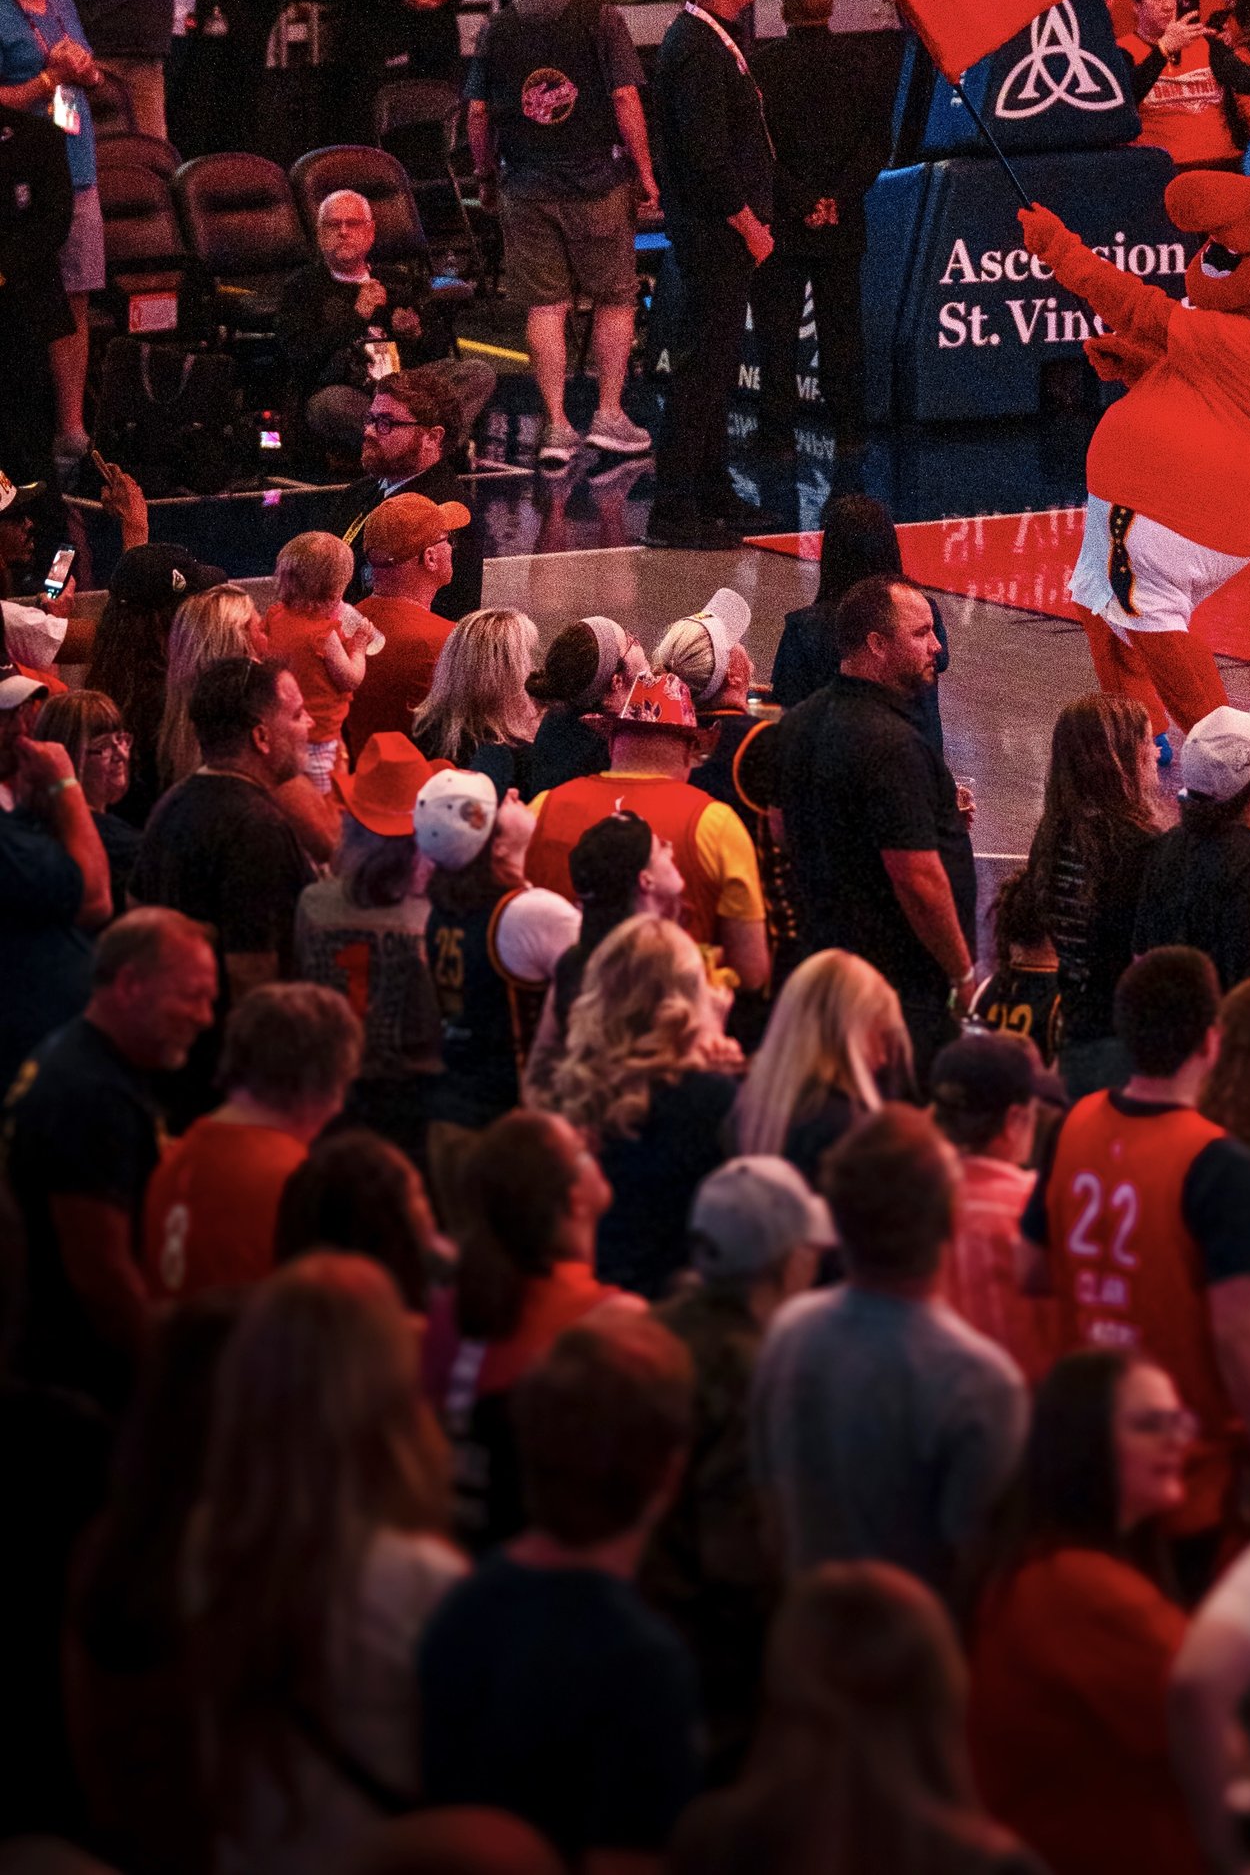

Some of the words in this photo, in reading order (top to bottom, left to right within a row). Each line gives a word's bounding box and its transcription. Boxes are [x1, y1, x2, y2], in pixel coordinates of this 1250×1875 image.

[938, 231, 1189, 285] Asceion
[938, 300, 1001, 350] St.
[1068, 1171, 1138, 1266] 22
